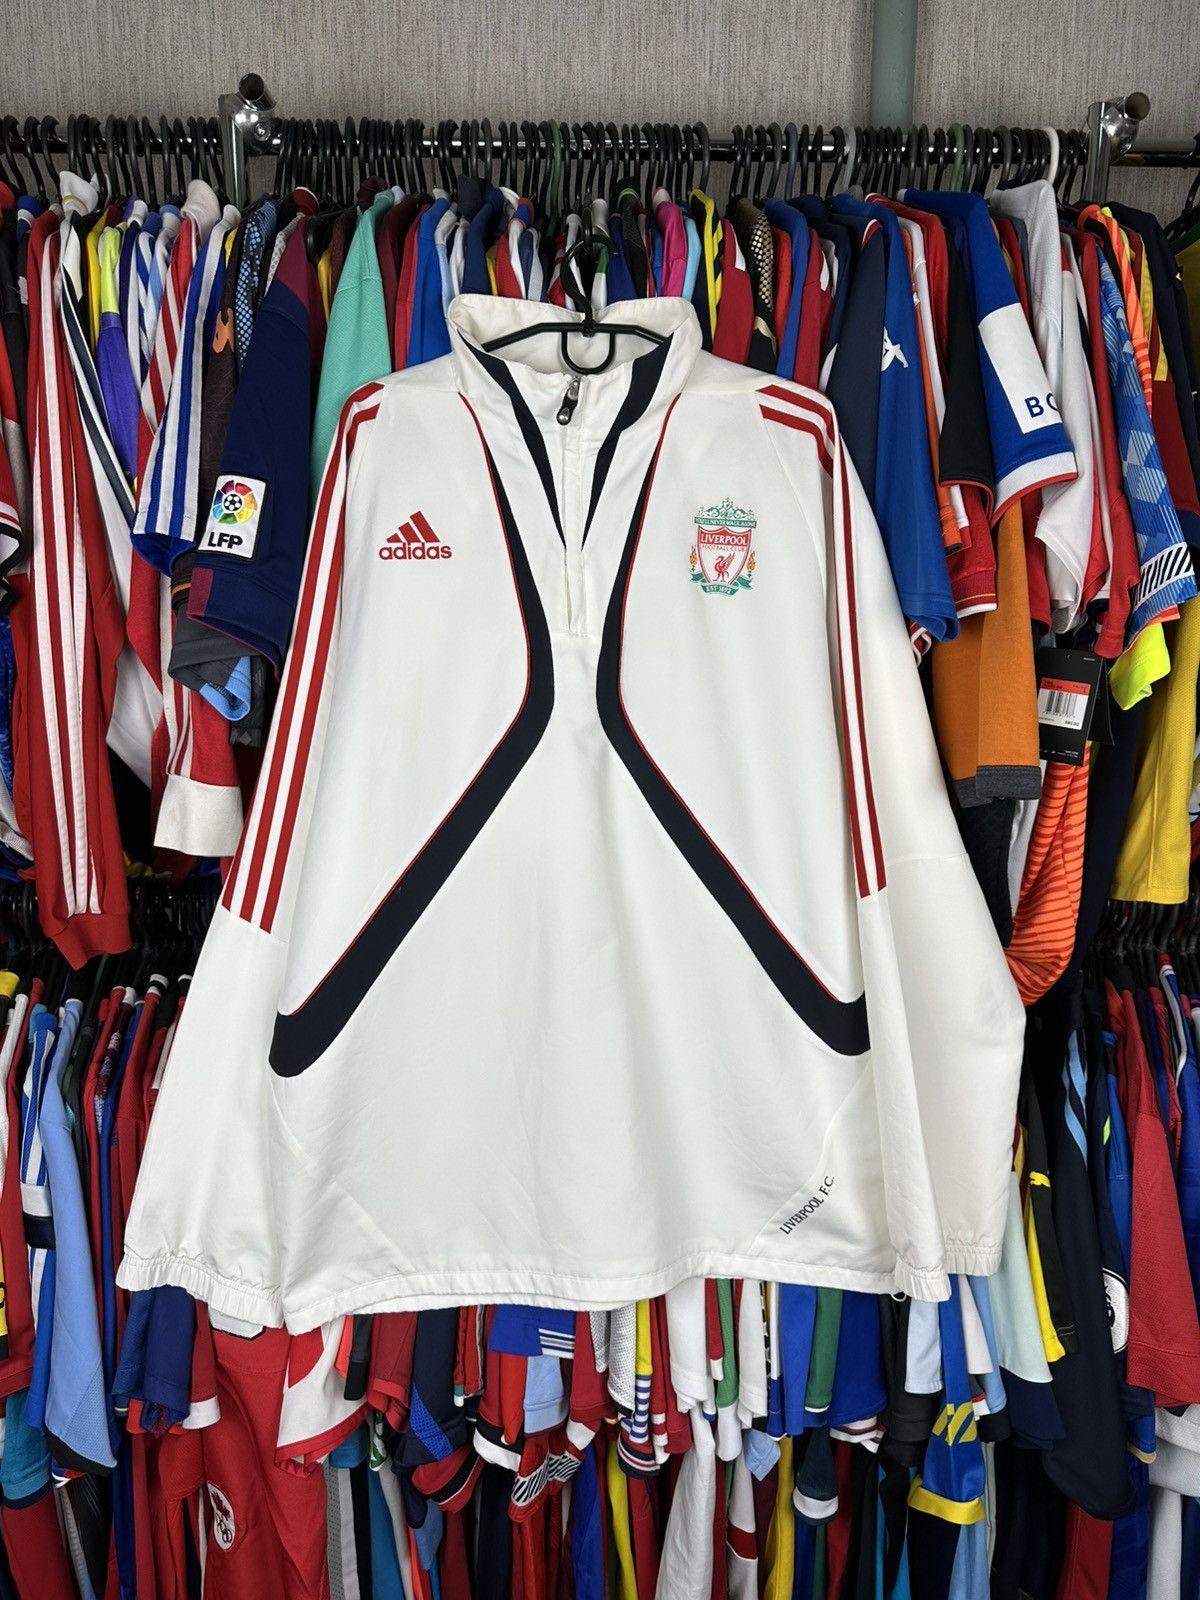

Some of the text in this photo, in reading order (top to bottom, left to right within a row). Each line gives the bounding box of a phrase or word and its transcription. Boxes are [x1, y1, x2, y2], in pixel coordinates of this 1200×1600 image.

[207, 531, 244, 549] LFP
[700, 533, 748, 545] LIVERPOOL
[378, 541, 453, 561] adidas
[779, 1175, 836, 1235] LIVERPOOL F.C.
